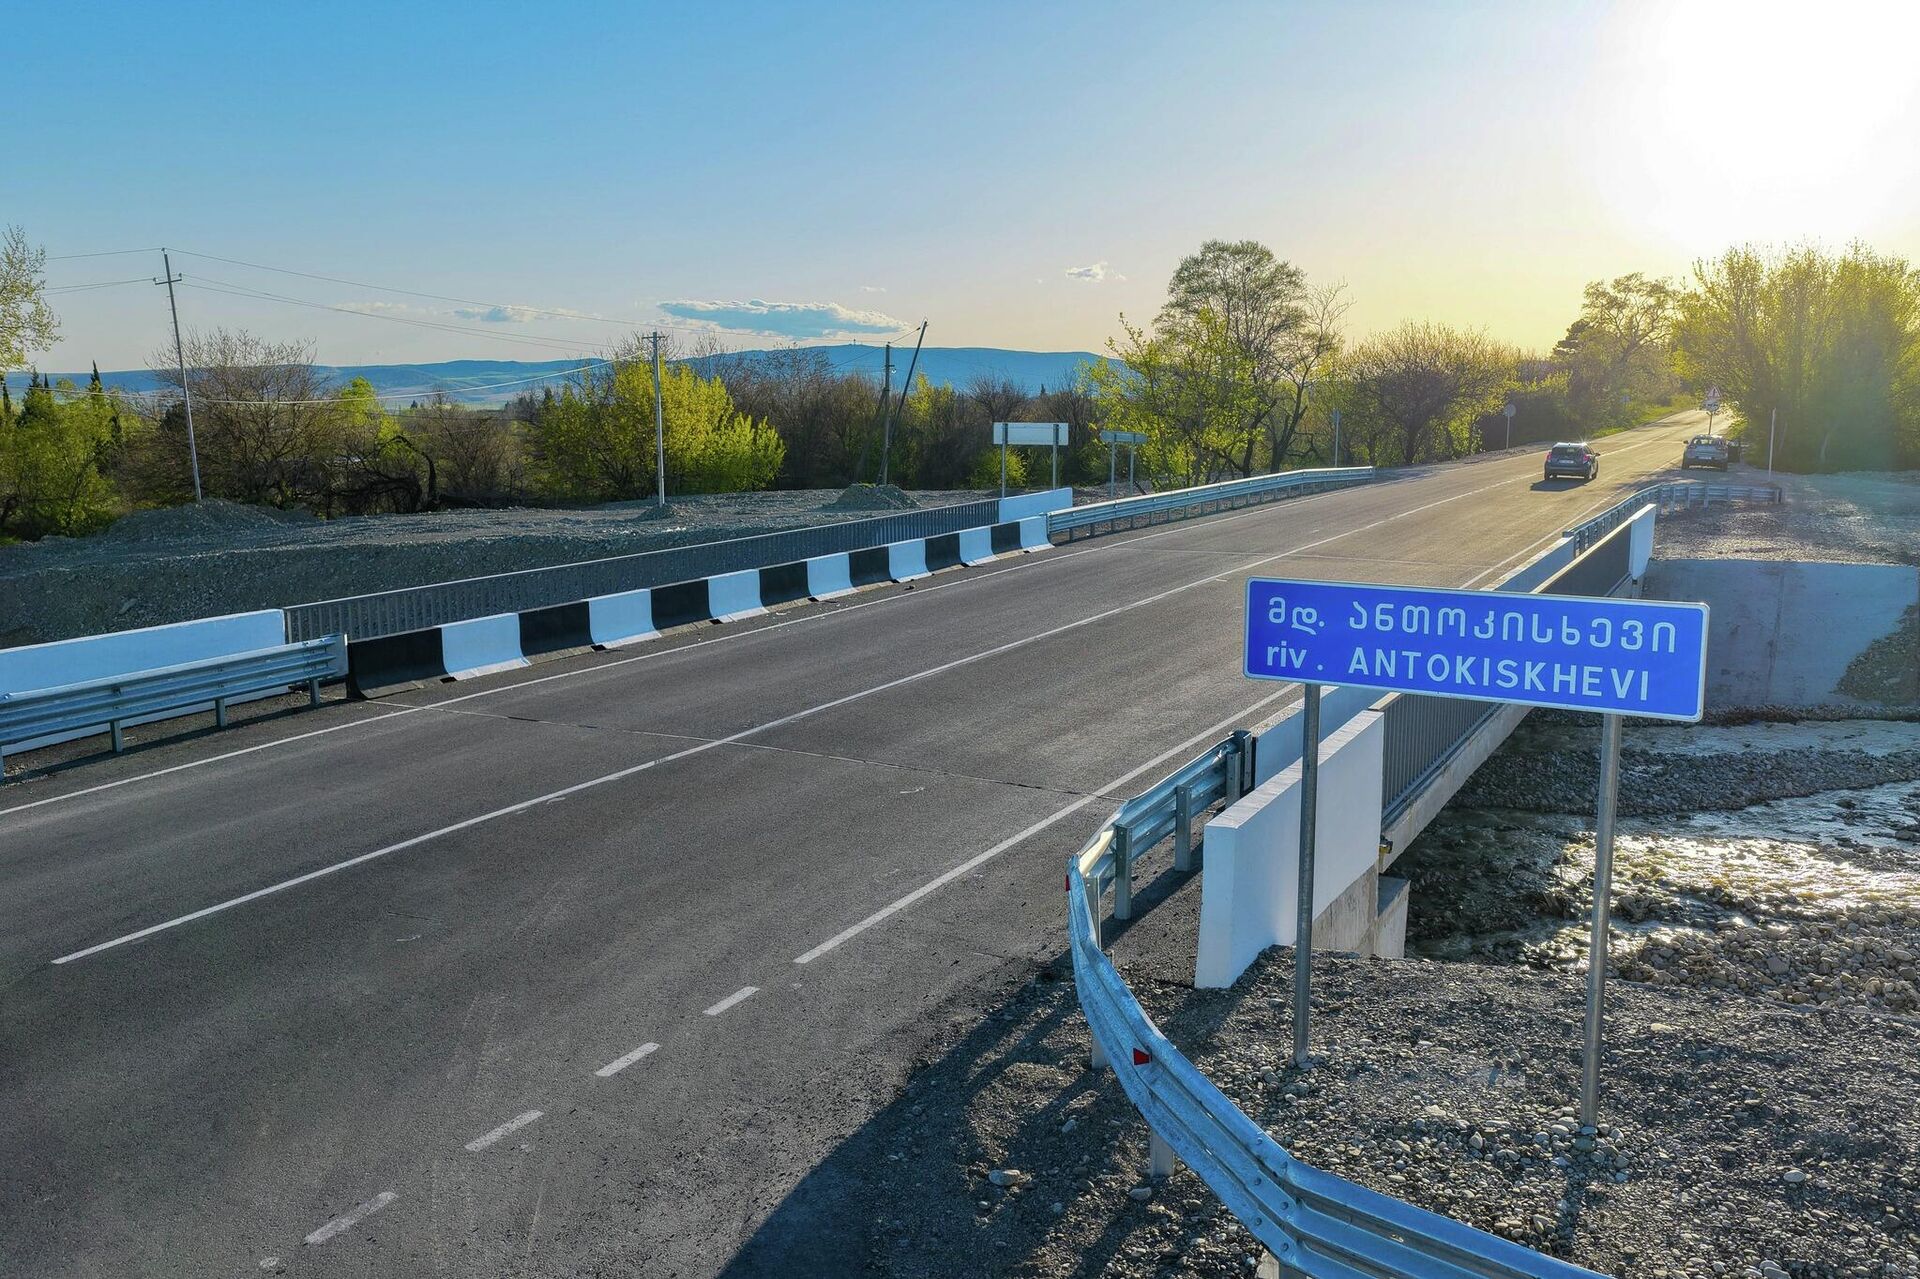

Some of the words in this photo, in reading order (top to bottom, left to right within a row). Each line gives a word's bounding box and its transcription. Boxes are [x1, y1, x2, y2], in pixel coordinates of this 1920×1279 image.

[1267, 596, 1326, 636] მდ.
[1348, 600, 1677, 654] ანთოკისხევი
[1347, 646, 1650, 701] ANTOKISKHEVI
